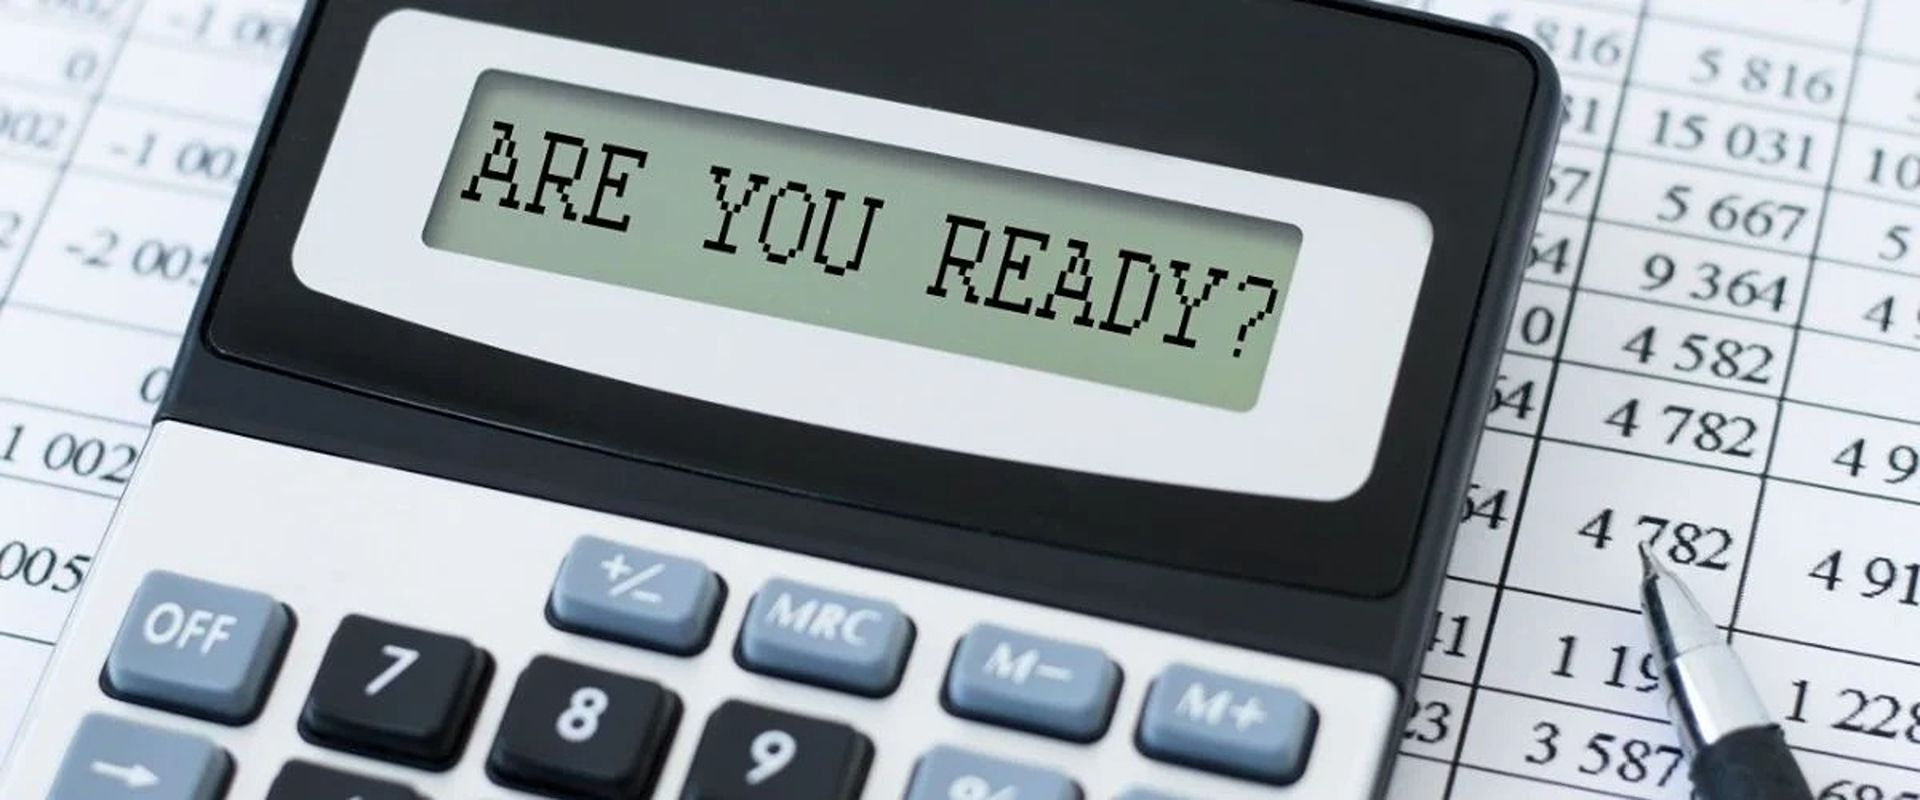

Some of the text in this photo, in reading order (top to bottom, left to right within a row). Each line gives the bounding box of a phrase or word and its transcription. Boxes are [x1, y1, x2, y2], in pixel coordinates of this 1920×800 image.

[1690, 48, 1838, 103] 5 816
[1651, 109, 1815, 171] 15 031
[460, 120, 1279, 358] ARE YOU READY?
[1657, 185, 1808, 242] 5 667
[65, 228, 119, 268] -2
[1878, 224, 1911, 262] 5
[1641, 253, 1788, 312] 9 364
[1521, 306, 1555, 346] 0
[1862, 296, 1895, 334] 4
[1622, 325, 1775, 384] 4 582
[1604, 398, 1759, 459] 4 782
[43, 433, 137, 484] 002
[1832, 438, 1868, 478] 4
[1578, 508, 1733, 571] 4 782
[1808, 550, 1920, 607] 4 91
[143, 602, 239, 656] OFF
[765, 592, 883, 646] MRC
[364, 644, 421, 696] 7
[1551, 634, 1577, 679] 1
[555, 686, 609, 743] 8
[1176, 682, 1269, 733] M+
[1785, 679, 1809, 723] 1
[744, 728, 797, 786] 9
[1525, 719, 1685, 788] 3 587
